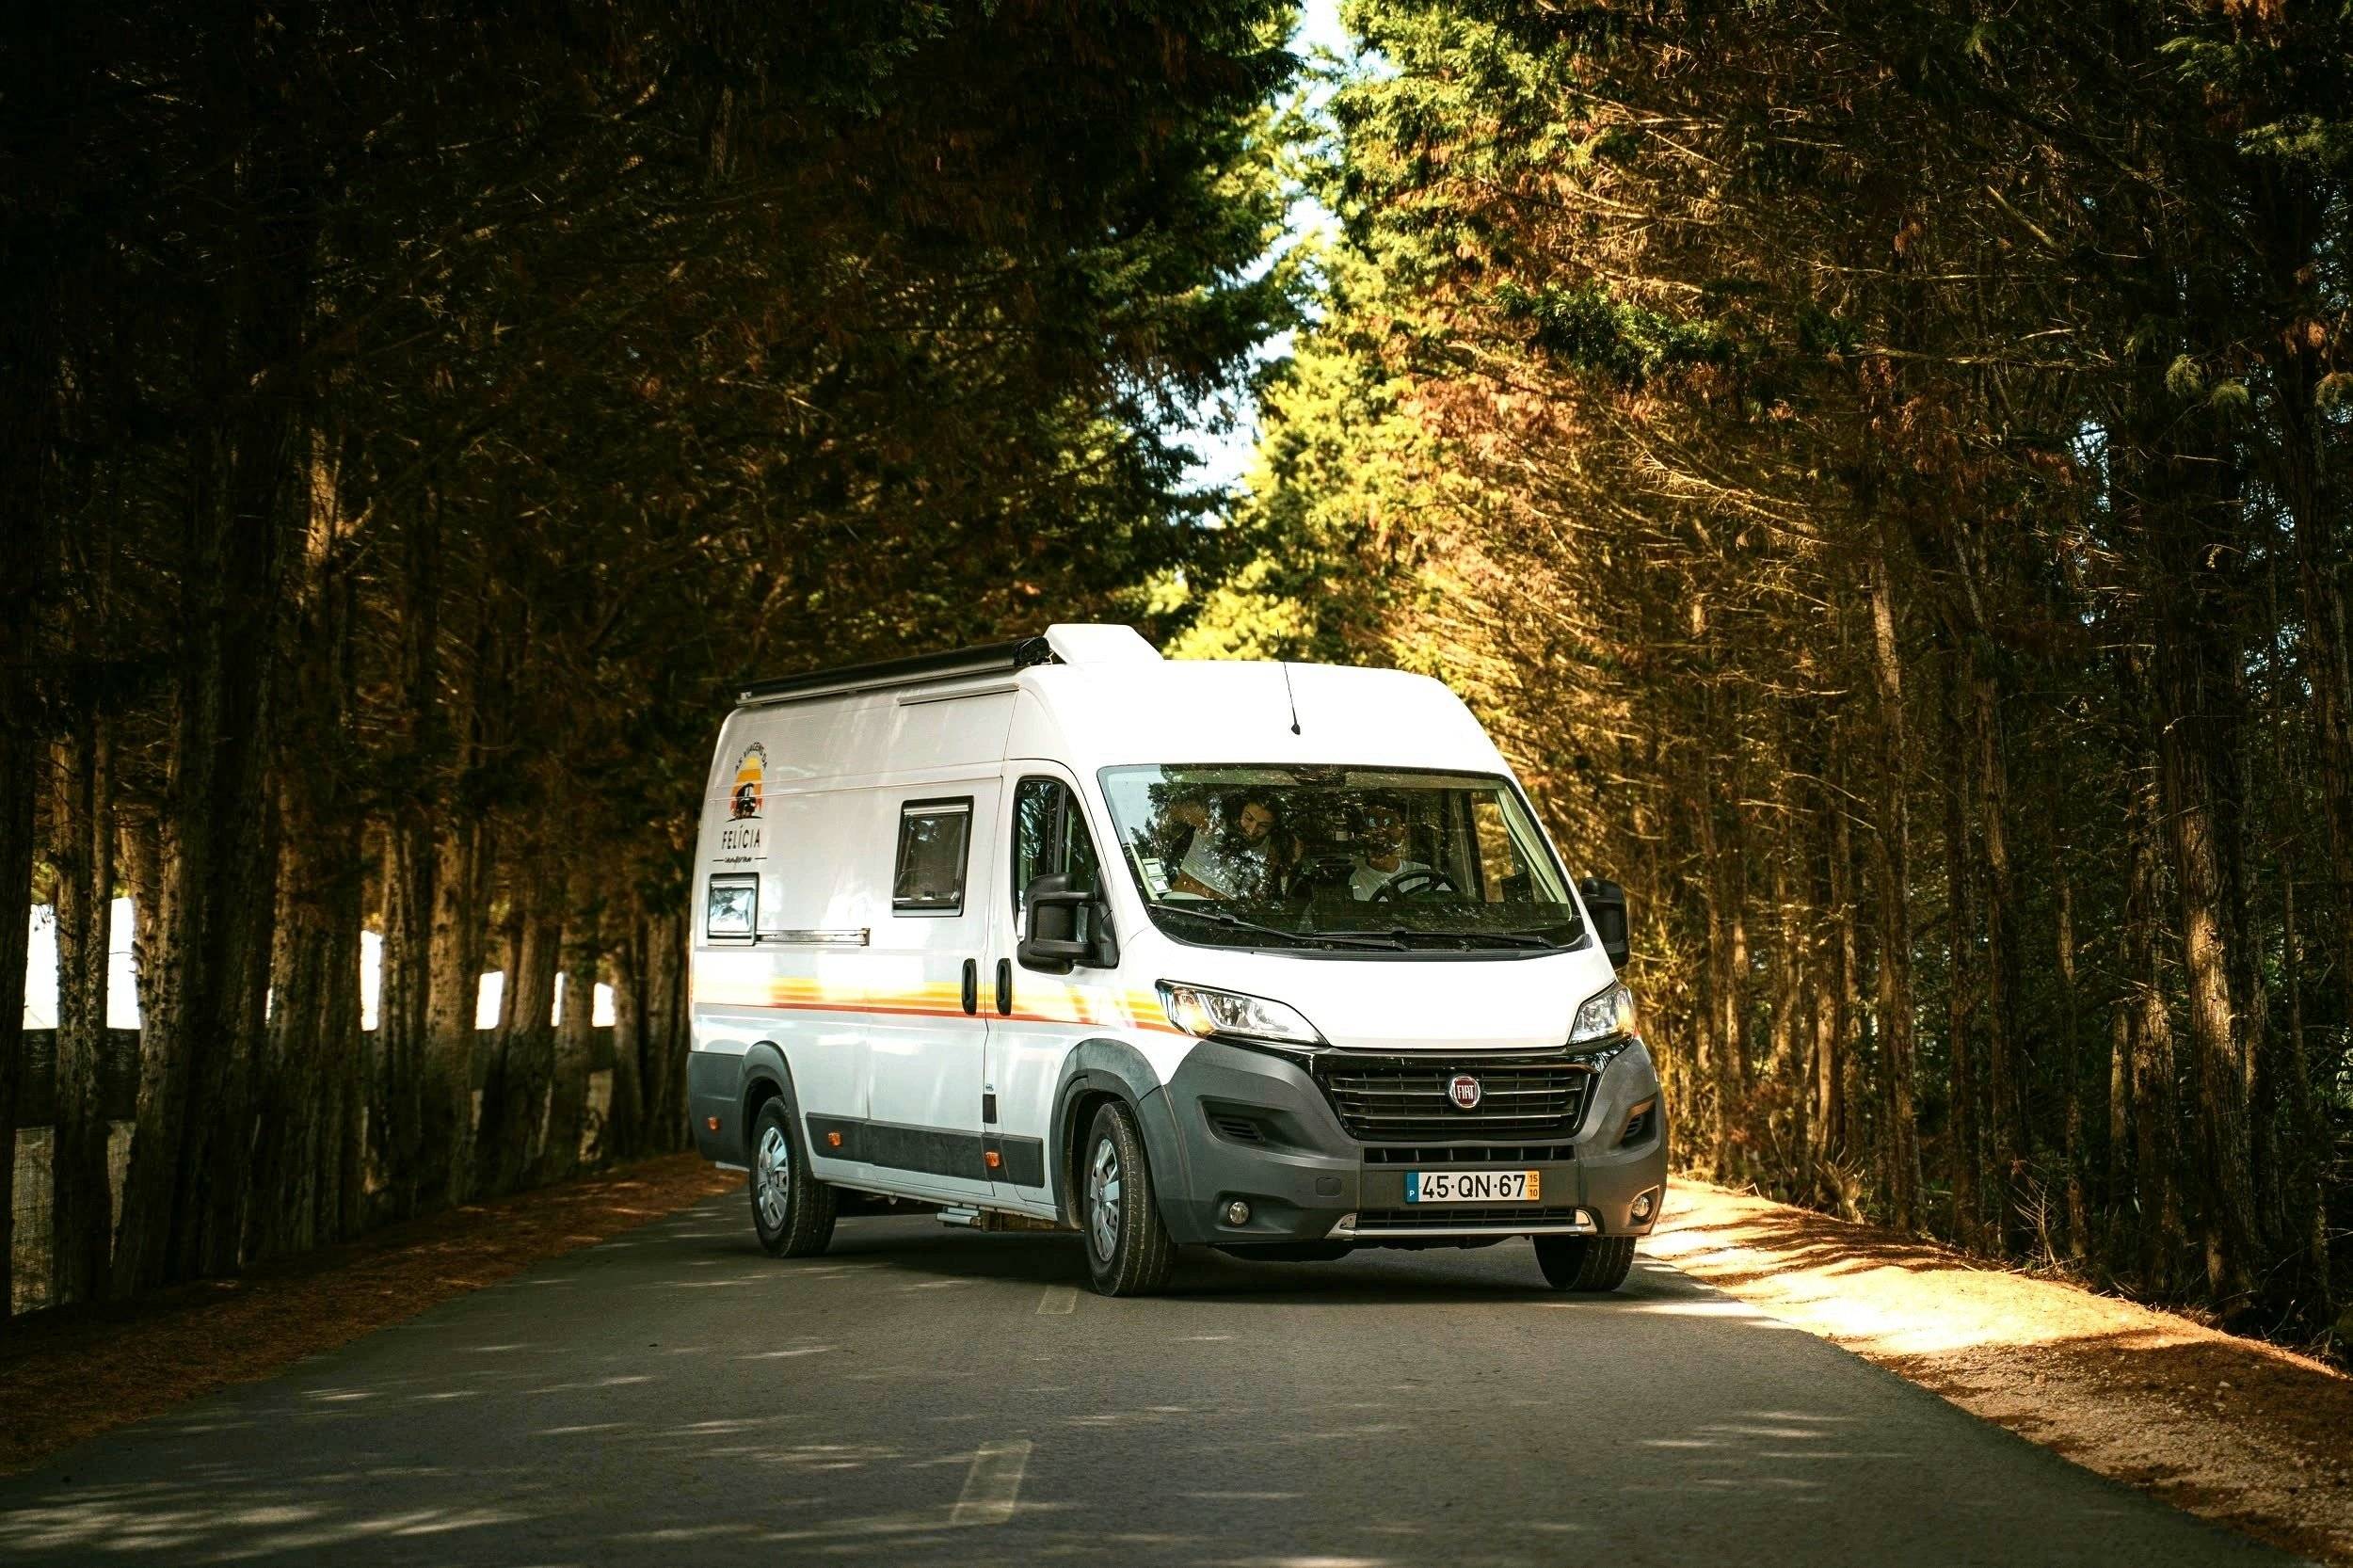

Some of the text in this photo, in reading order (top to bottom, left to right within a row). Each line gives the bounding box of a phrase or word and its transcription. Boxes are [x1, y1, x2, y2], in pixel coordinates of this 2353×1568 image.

[721, 824, 760, 850] FELÍCIA
[1456, 1084, 1474, 1099] FIAT
[1529, 1174, 1538, 1183] 15
[1529, 1189, 1538, 1197] 10
